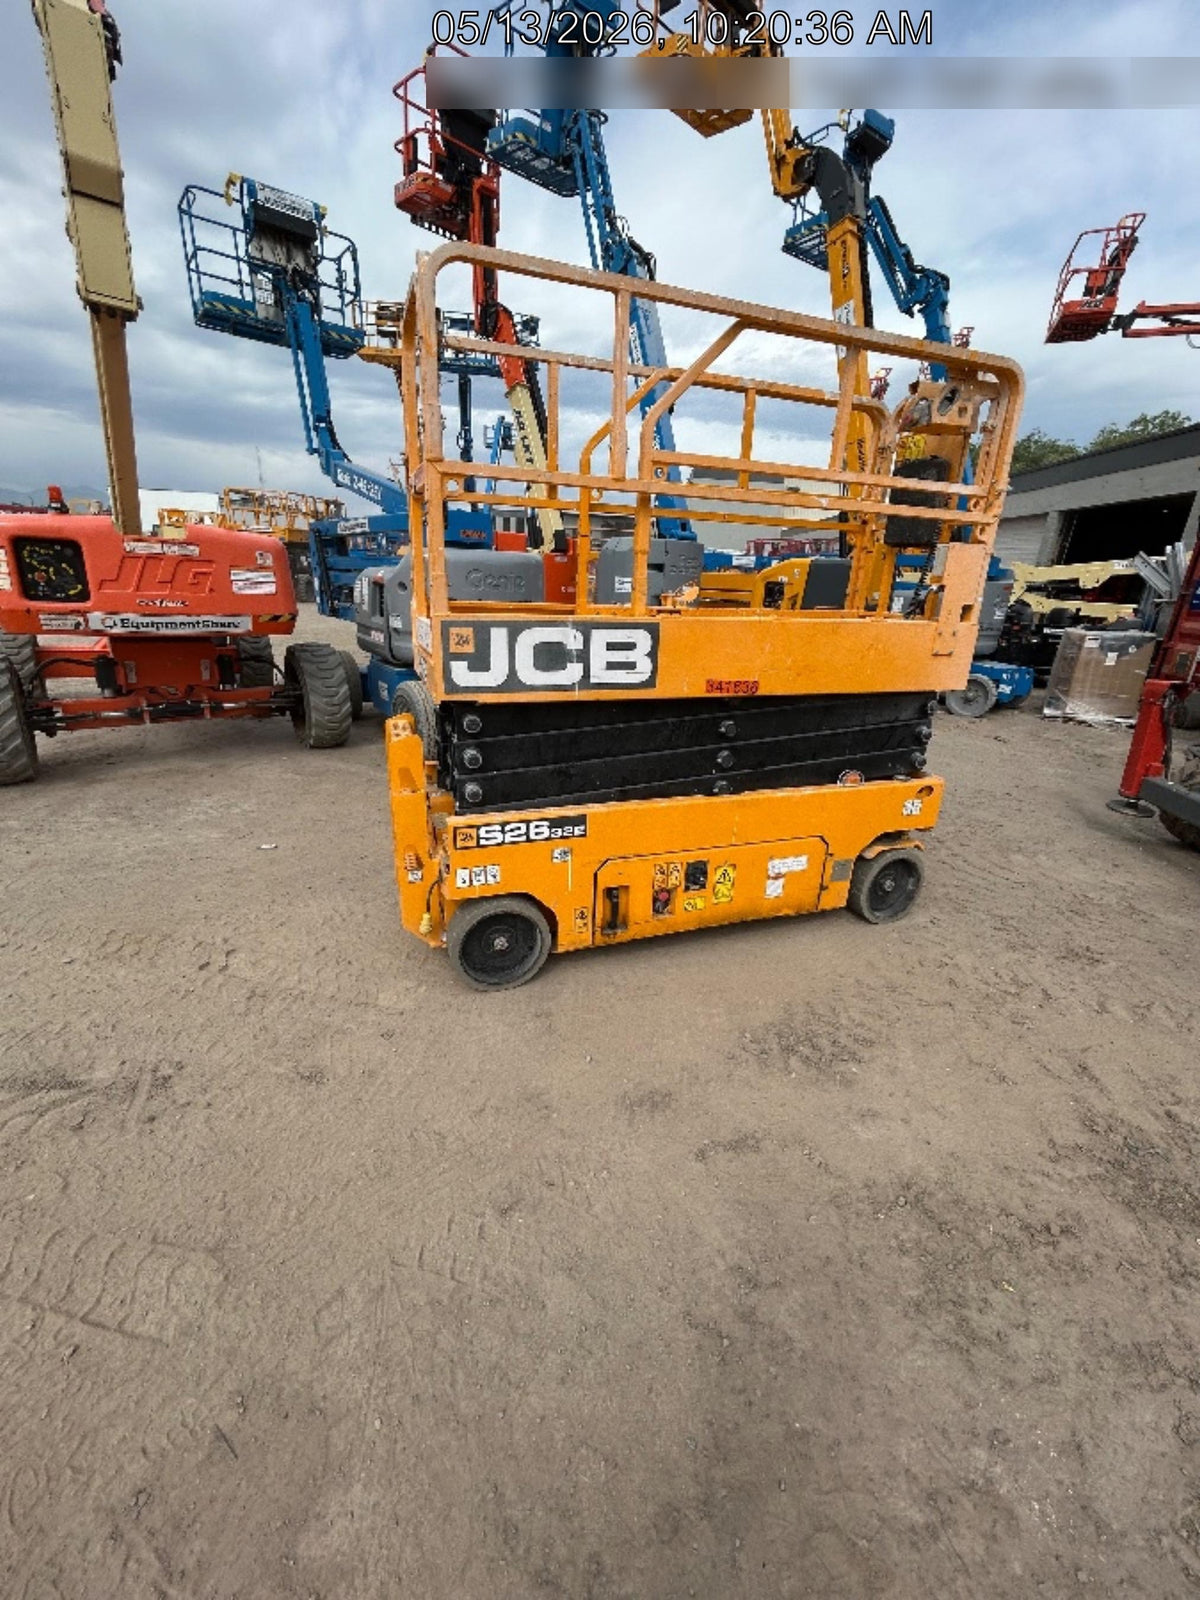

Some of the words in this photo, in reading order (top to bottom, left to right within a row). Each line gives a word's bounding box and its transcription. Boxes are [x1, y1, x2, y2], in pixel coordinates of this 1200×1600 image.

[98, 556, 217, 596] JLG
[465, 568, 526, 592] Genie
[119, 617, 241, 631] EquipmentShare
[449, 627, 653, 687] JCB
